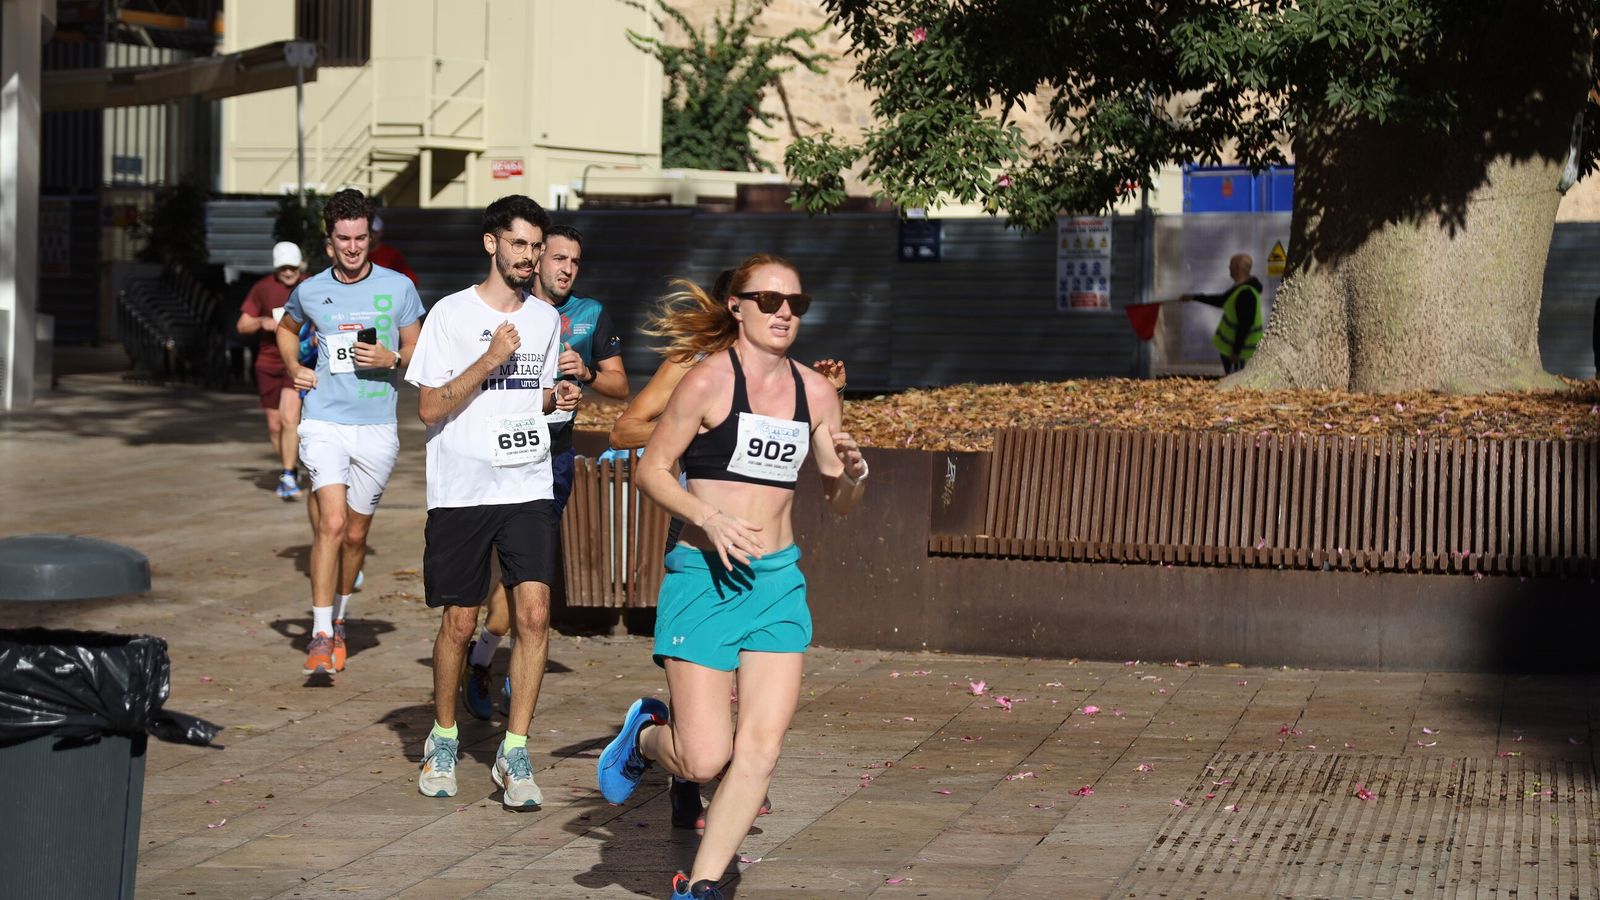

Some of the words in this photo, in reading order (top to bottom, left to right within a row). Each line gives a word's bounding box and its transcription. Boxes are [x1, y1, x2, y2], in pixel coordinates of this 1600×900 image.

[336, 346, 356, 361] 89
[510, 353, 545, 363] ERSIDA
[498, 430, 540, 450] 695
[747, 437, 797, 462] 902
